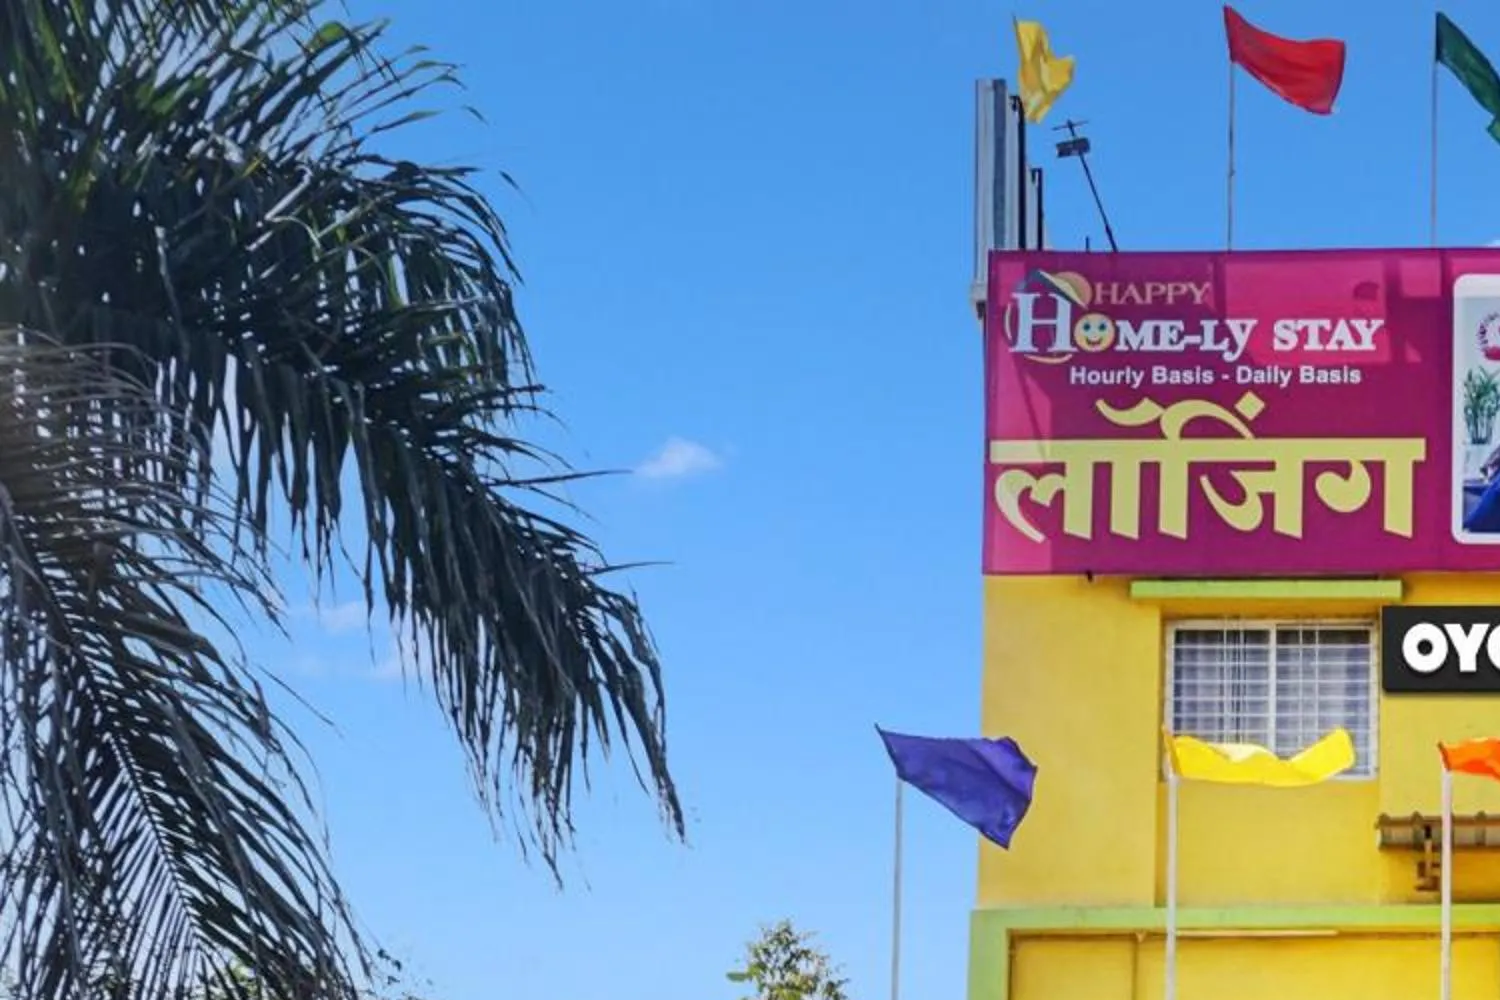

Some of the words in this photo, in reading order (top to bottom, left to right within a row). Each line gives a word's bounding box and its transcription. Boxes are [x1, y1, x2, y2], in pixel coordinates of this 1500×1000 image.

[1093, 281, 1211, 306] HAPPY
[1273, 319, 1384, 352] STAY
[1070, 366, 1145, 389] Hourly
[1152, 366, 1214, 385] Basis
[1236, 367, 1292, 389] Daily
[1300, 367, 1362, 386] Basis
[989, 390, 1426, 543] लॉजिंग
